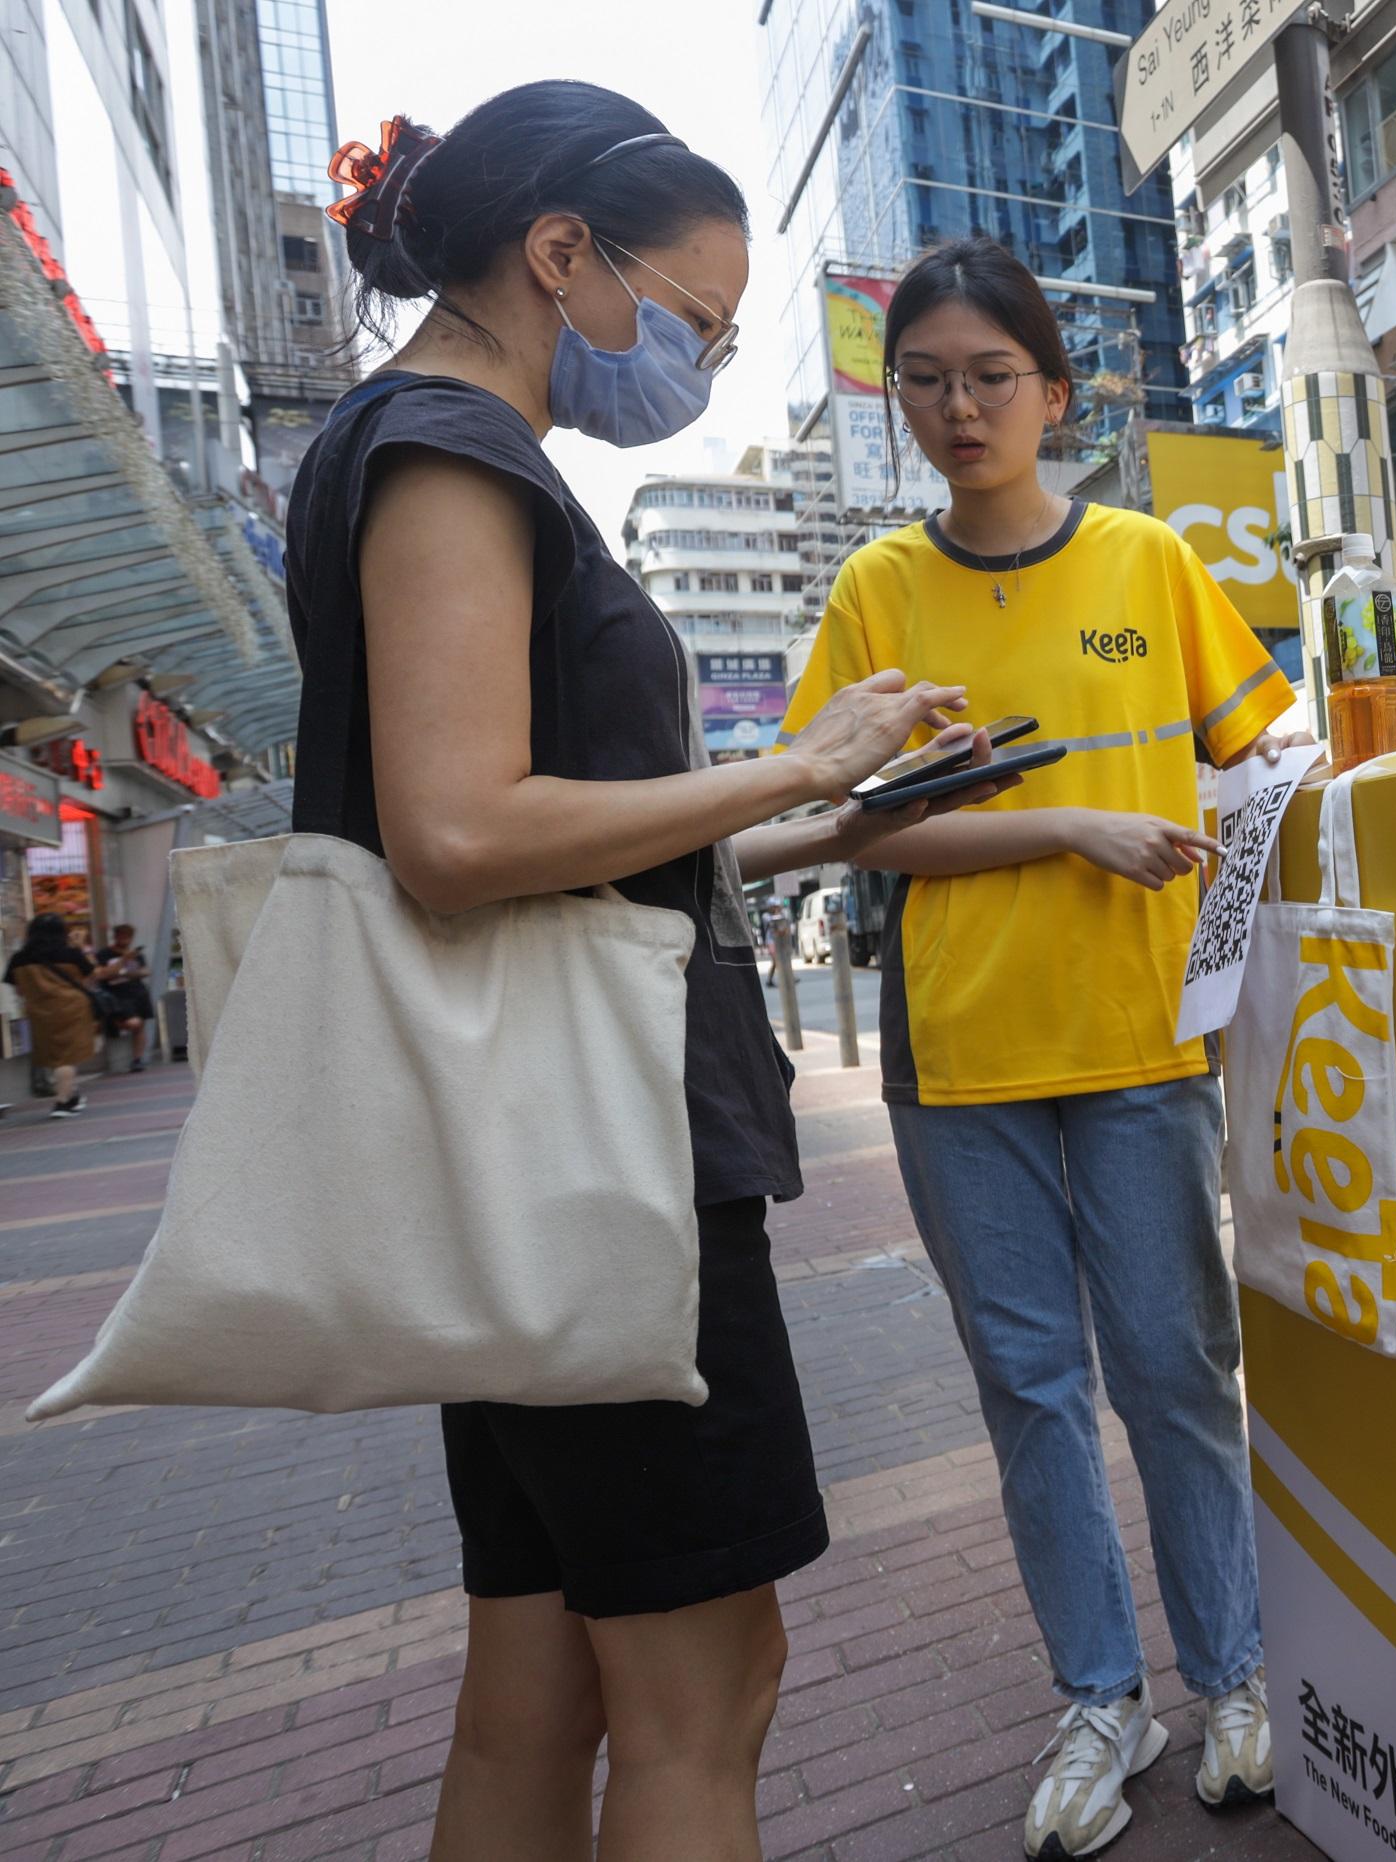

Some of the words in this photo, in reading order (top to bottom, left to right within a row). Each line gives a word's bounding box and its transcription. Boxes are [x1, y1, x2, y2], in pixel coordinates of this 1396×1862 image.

[1137, 38, 1161, 87] Sai
[1161, 0, 1211, 52] Yeung
[851, 425, 883, 440] FOR
[1079, 627, 1148, 664] KeeTa
[742, 672, 772, 680] PLAZA
[1302, 1753, 1328, 1790] The
[1330, 1779, 1361, 1818] New
